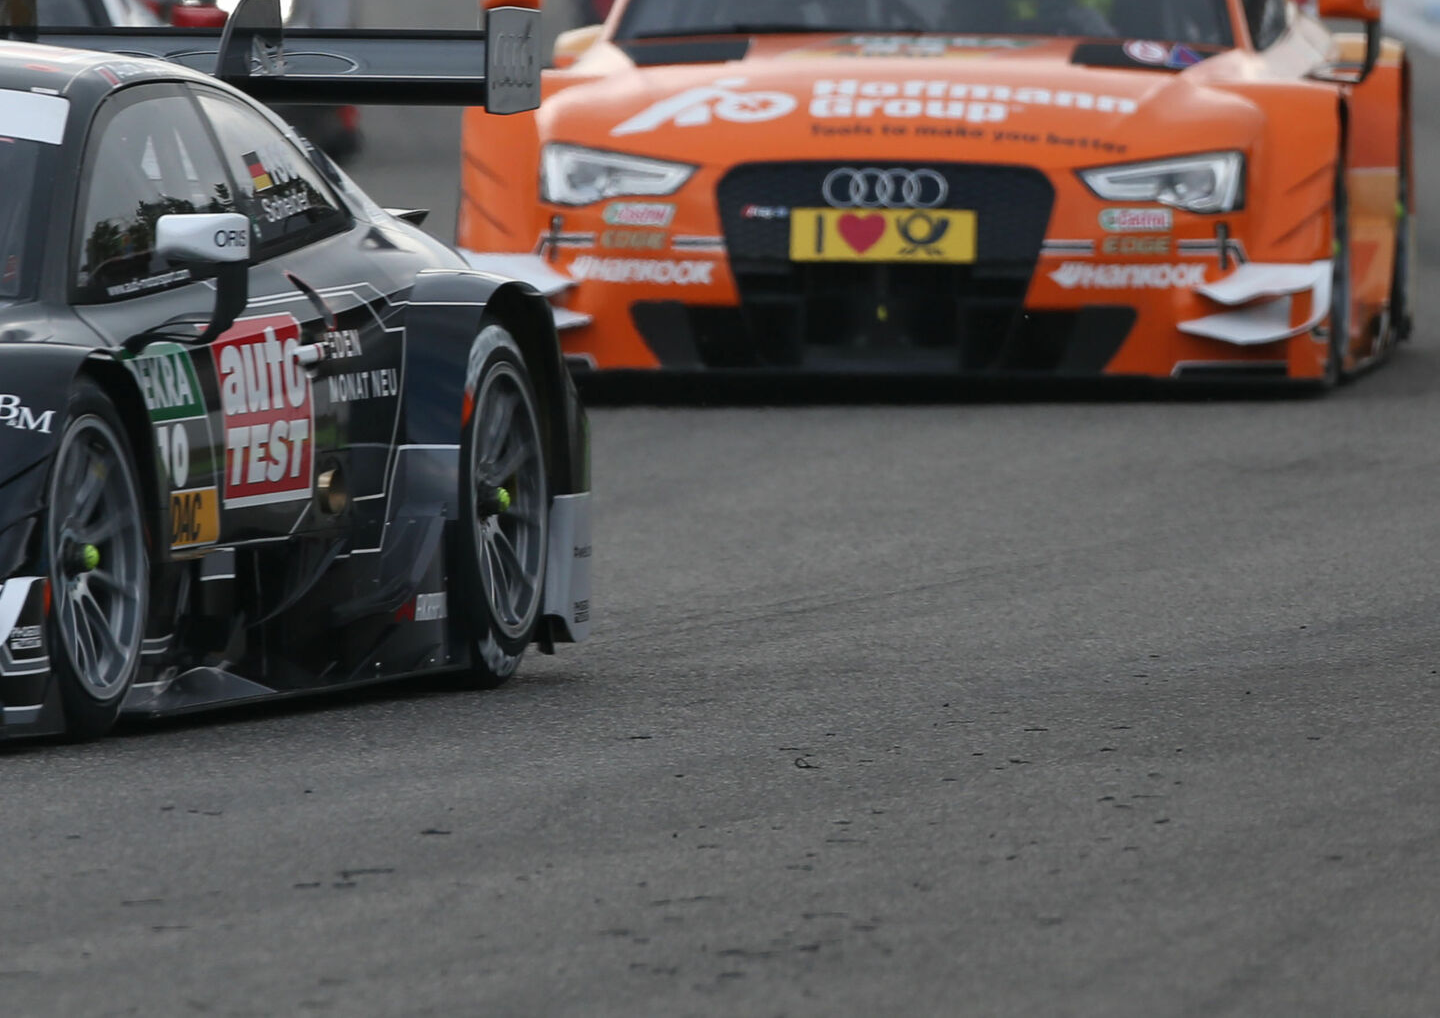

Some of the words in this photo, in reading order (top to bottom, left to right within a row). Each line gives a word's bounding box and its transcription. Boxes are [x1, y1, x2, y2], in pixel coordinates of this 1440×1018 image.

[806, 96, 1010, 124] Group
[810, 78, 1140, 116] Hoffmann
[214, 230, 247, 248] ORIS
[220, 327, 306, 416] auto
[328, 371, 369, 402] MONAT
[371, 368, 397, 397] NEU
[228, 419, 309, 486] TEST
